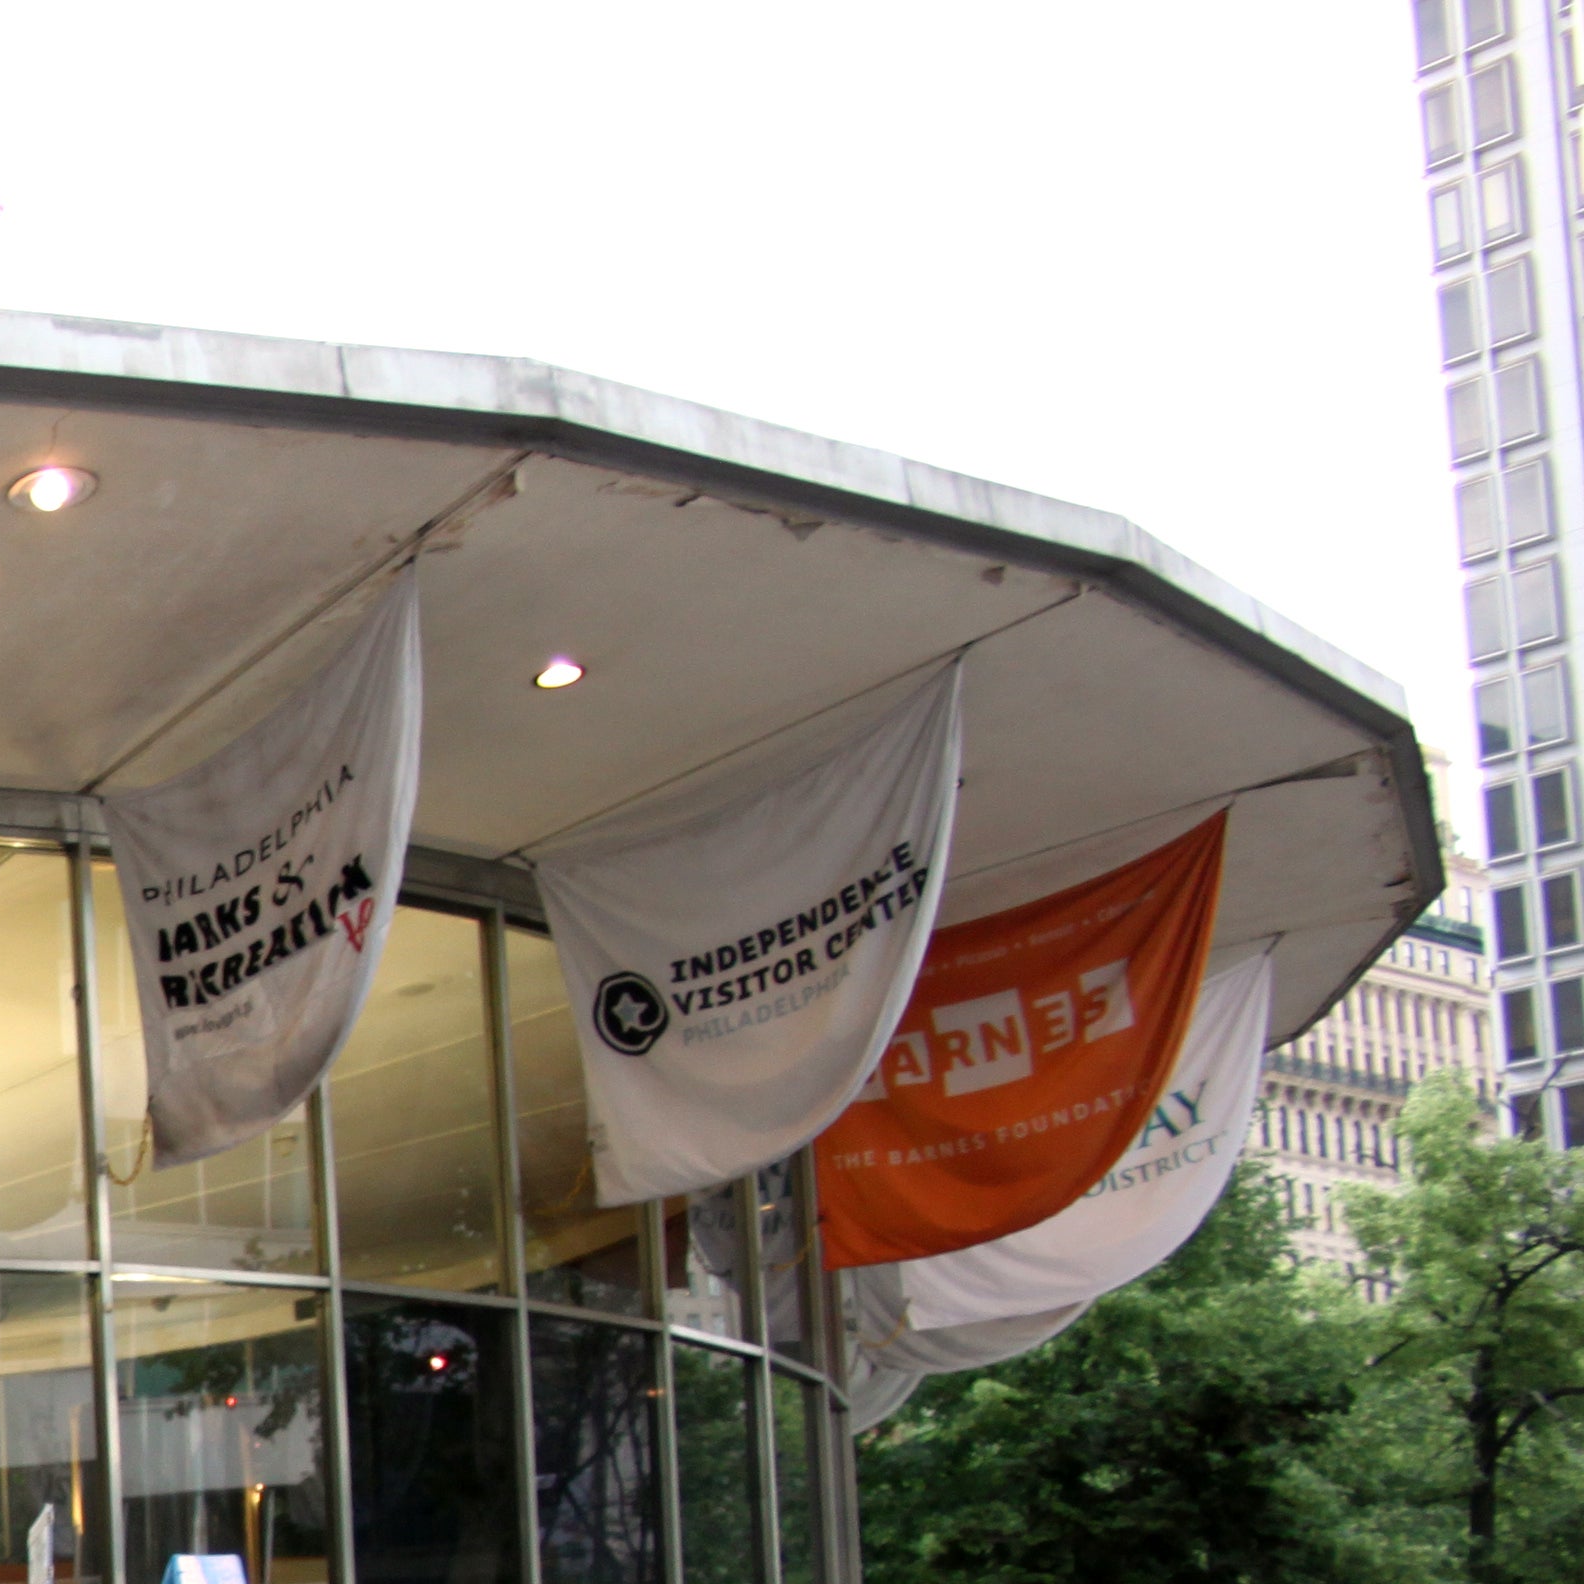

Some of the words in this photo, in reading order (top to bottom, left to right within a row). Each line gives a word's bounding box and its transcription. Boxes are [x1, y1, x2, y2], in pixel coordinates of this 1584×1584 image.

[671, 841, 914, 983] INDEPENDENCE
[672, 948, 817, 1016] VISITOR
[684, 963, 850, 1046] PHILADELPHIA
[860, 958, 1135, 1102] ARNES
[833, 1150, 875, 1171] THE
[889, 1133, 985, 1165] BARNES
